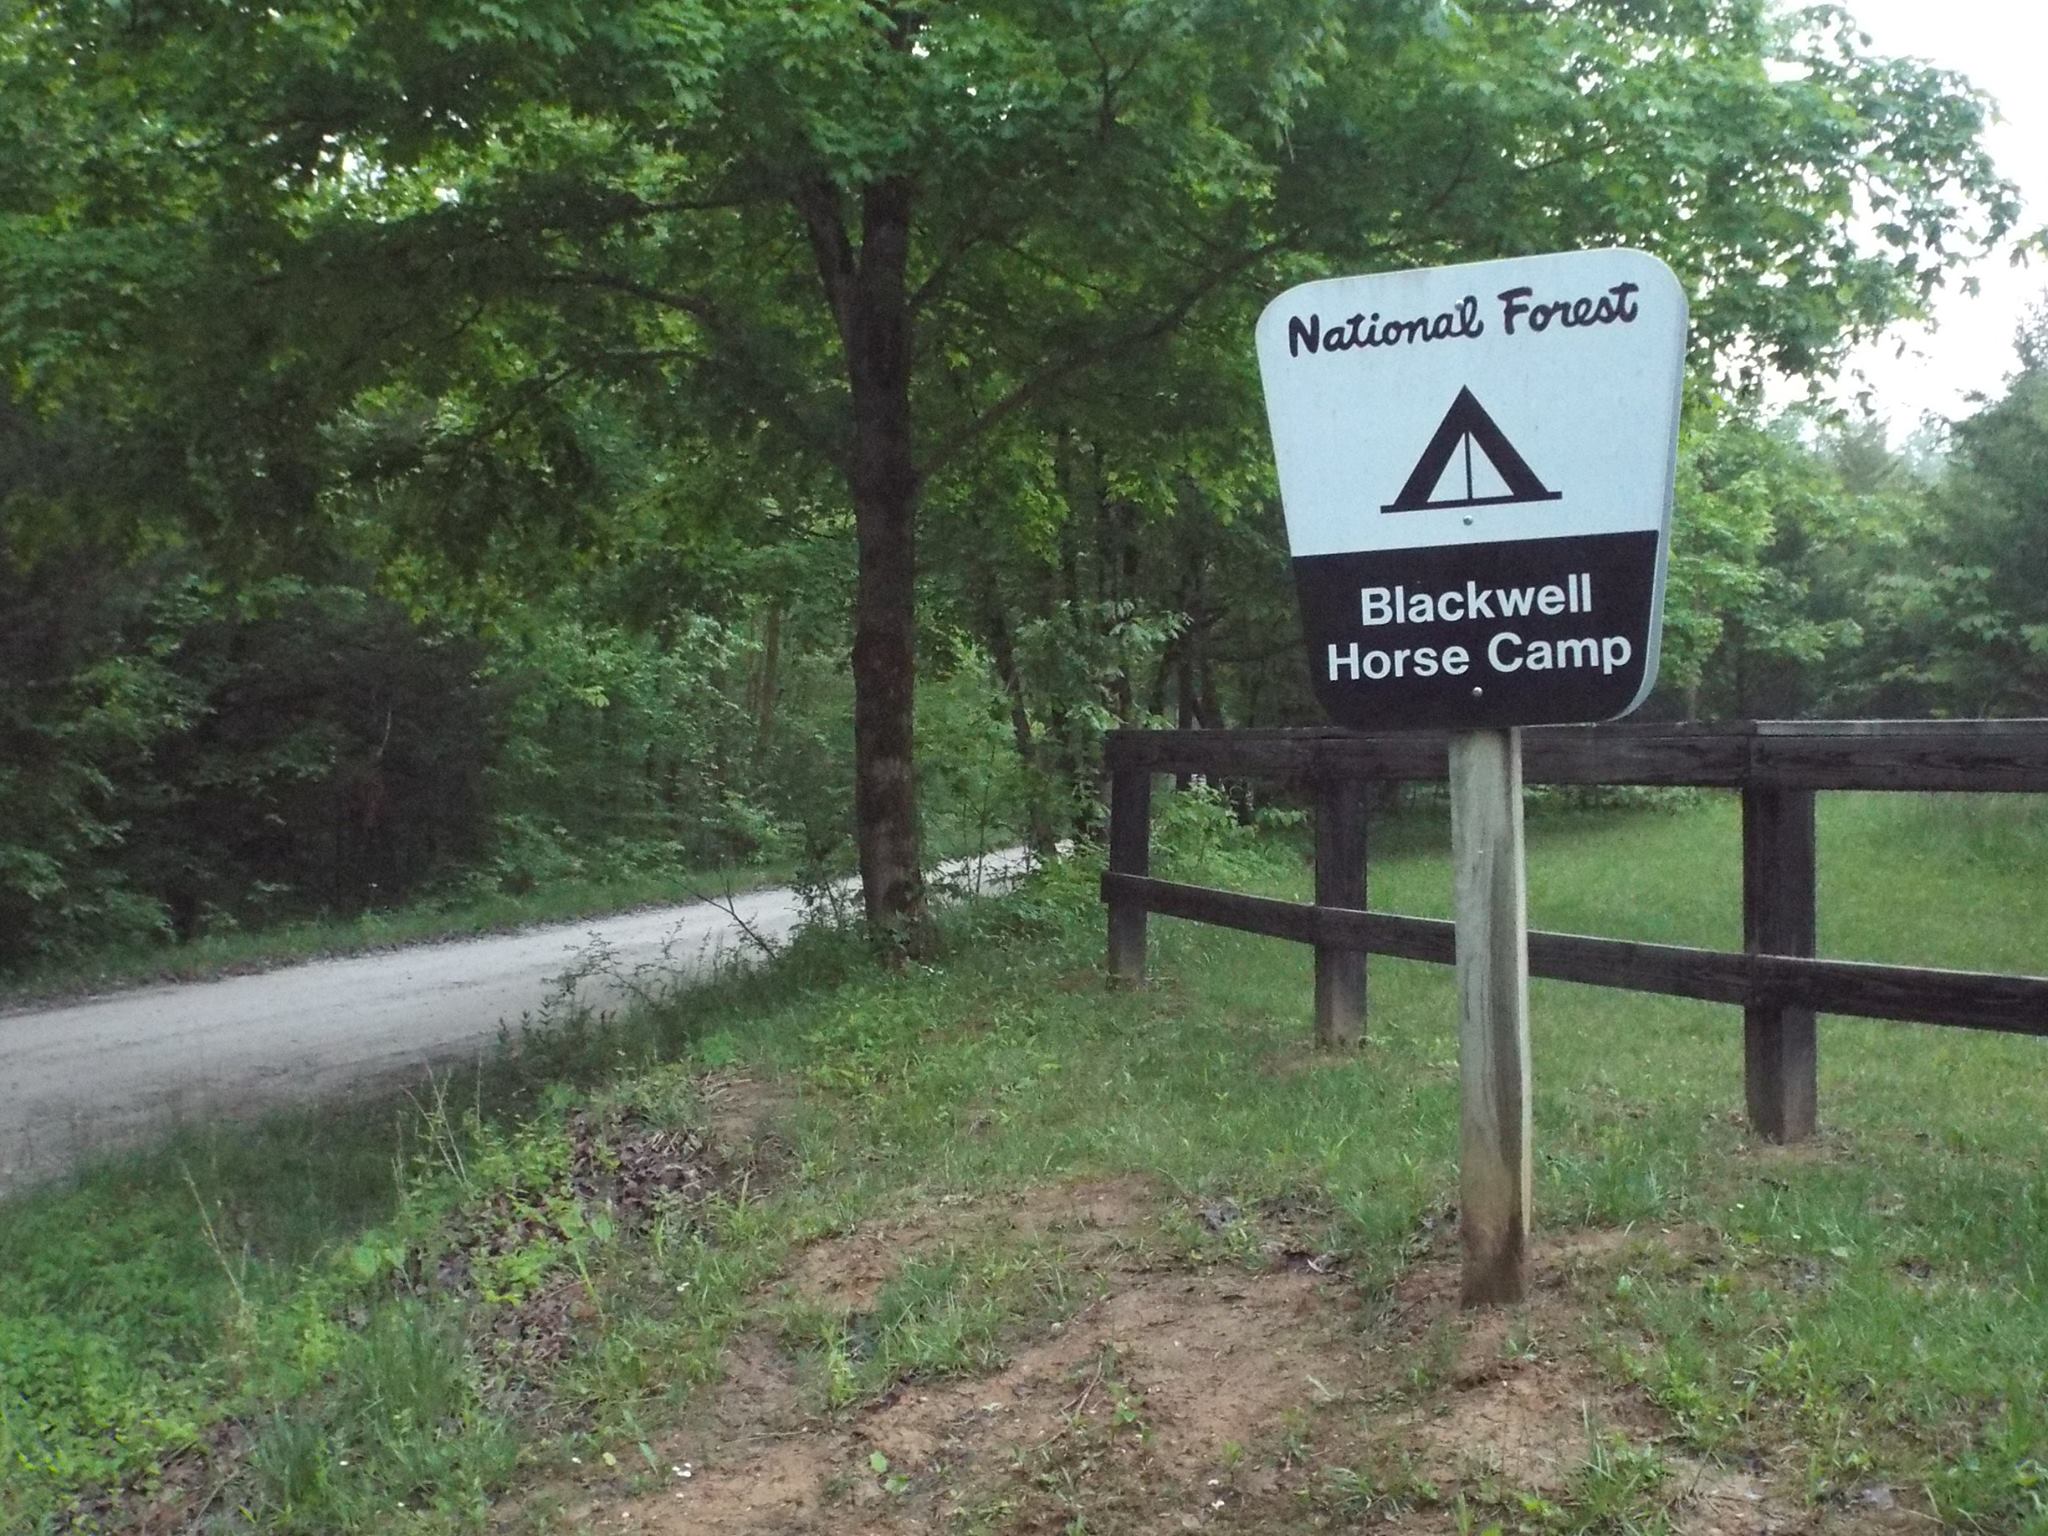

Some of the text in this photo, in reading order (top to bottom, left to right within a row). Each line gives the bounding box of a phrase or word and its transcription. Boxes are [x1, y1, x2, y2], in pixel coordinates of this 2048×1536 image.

[1289, 282, 1639, 358] National Forest
[1361, 573, 1592, 626] Blackwell
[1327, 631, 1632, 682] Horse Camp
